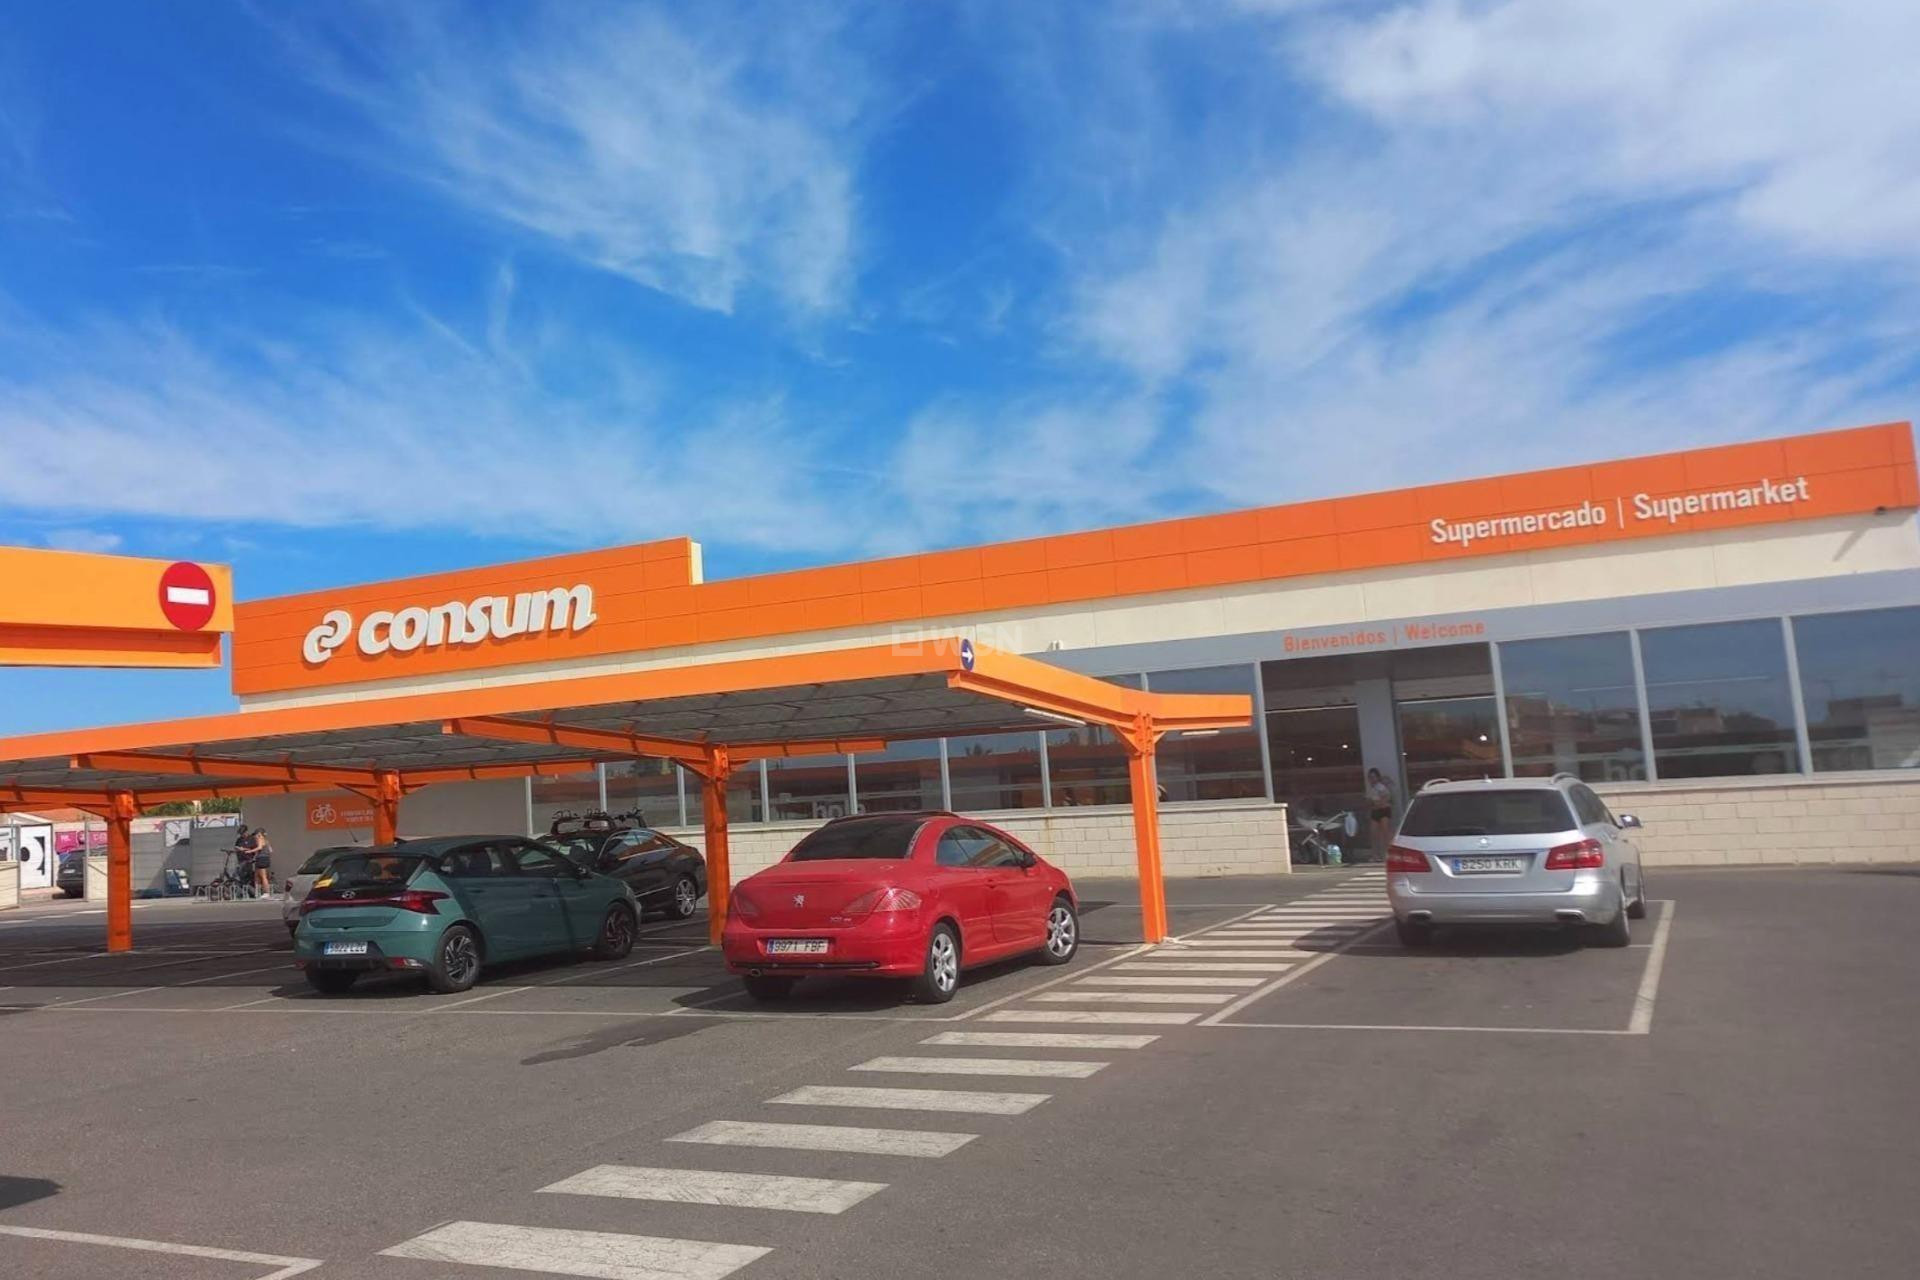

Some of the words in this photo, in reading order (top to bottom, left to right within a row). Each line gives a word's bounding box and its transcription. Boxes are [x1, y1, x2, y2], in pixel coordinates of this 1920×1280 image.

[1430, 499, 1607, 547] Supermercado
[1632, 476, 1810, 523] Supermarket
[358, 584, 597, 655] consum
[1283, 630, 1386, 652] Bienvenidos
[1404, 620, 1485, 641] Welcome
